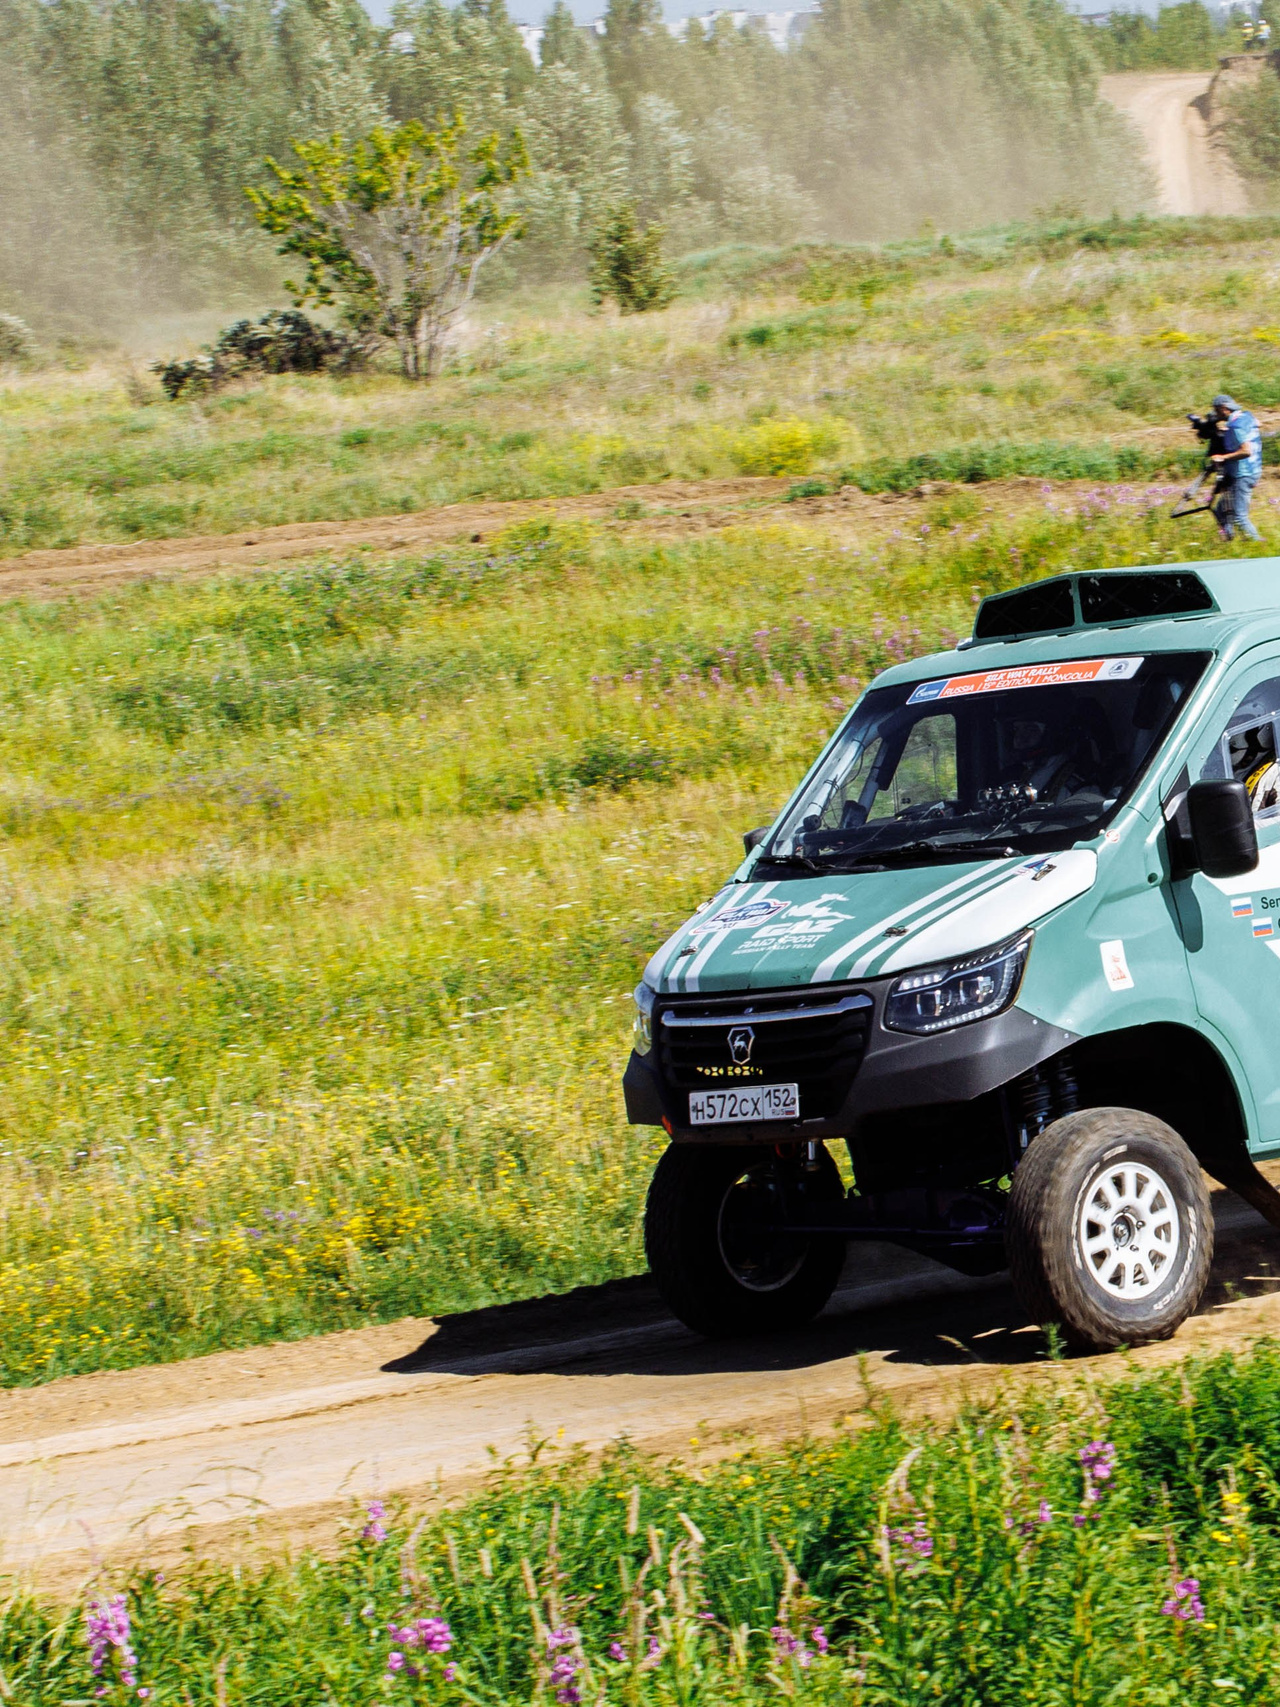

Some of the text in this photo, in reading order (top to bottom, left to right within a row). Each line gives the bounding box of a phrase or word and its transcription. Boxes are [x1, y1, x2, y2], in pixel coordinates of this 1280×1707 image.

[943, 684, 975, 696] RUSSIA
[996, 677, 1034, 688] EDITION
[1042, 671, 1094, 682] MONGOLIA
[985, 666, 1061, 683] SILK WAY RALLY
[751, 919, 845, 939] GAZ
[737, 938, 777, 949] RAID
[764, 1088, 791, 1108] 152
